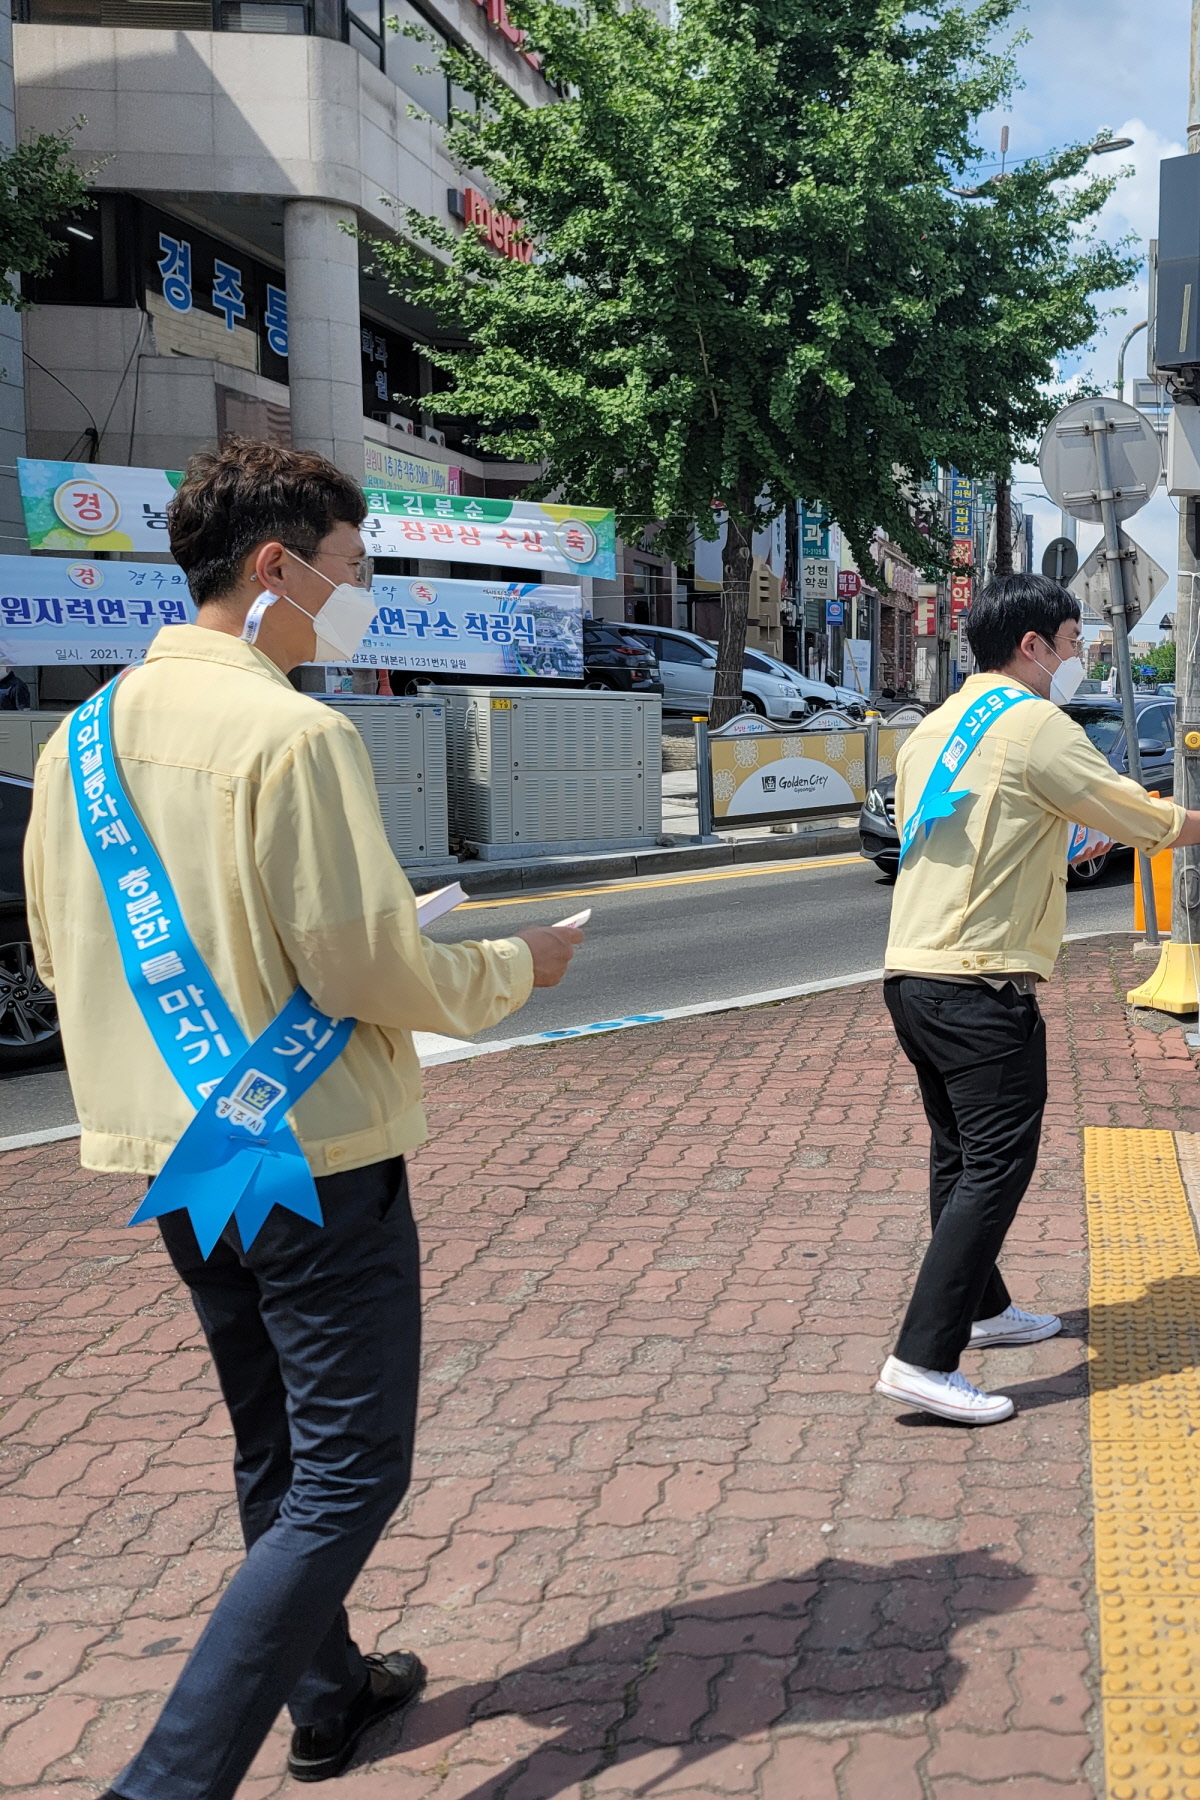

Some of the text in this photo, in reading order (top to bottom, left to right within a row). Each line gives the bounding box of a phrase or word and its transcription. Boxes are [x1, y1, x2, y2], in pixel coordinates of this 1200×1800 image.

[73, 493, 103, 521] 경
[399, 520, 482, 546] 장관상
[495, 528, 543, 553] 수상
[566, 529, 586, 553] 축
[74, 568, 95, 586] 경
[804, 565, 828, 576] 성현
[805, 578, 828, 589] 학원
[415, 586, 432, 602] 축
[1, 596, 188, 625] 원자력연구원
[465, 612, 535, 645] 착공식
[381, 656, 407, 667] 대본리
[410, 657, 448, 668] 1231번지
[450, 658, 467, 670] 일원
[964, 694, 1005, 737] 마시기
[779, 774, 829, 789] Golden City
[117, 865, 172, 951] 충분한
[140, 949, 187, 986] 물
[157, 983, 233, 1066] 마시기
